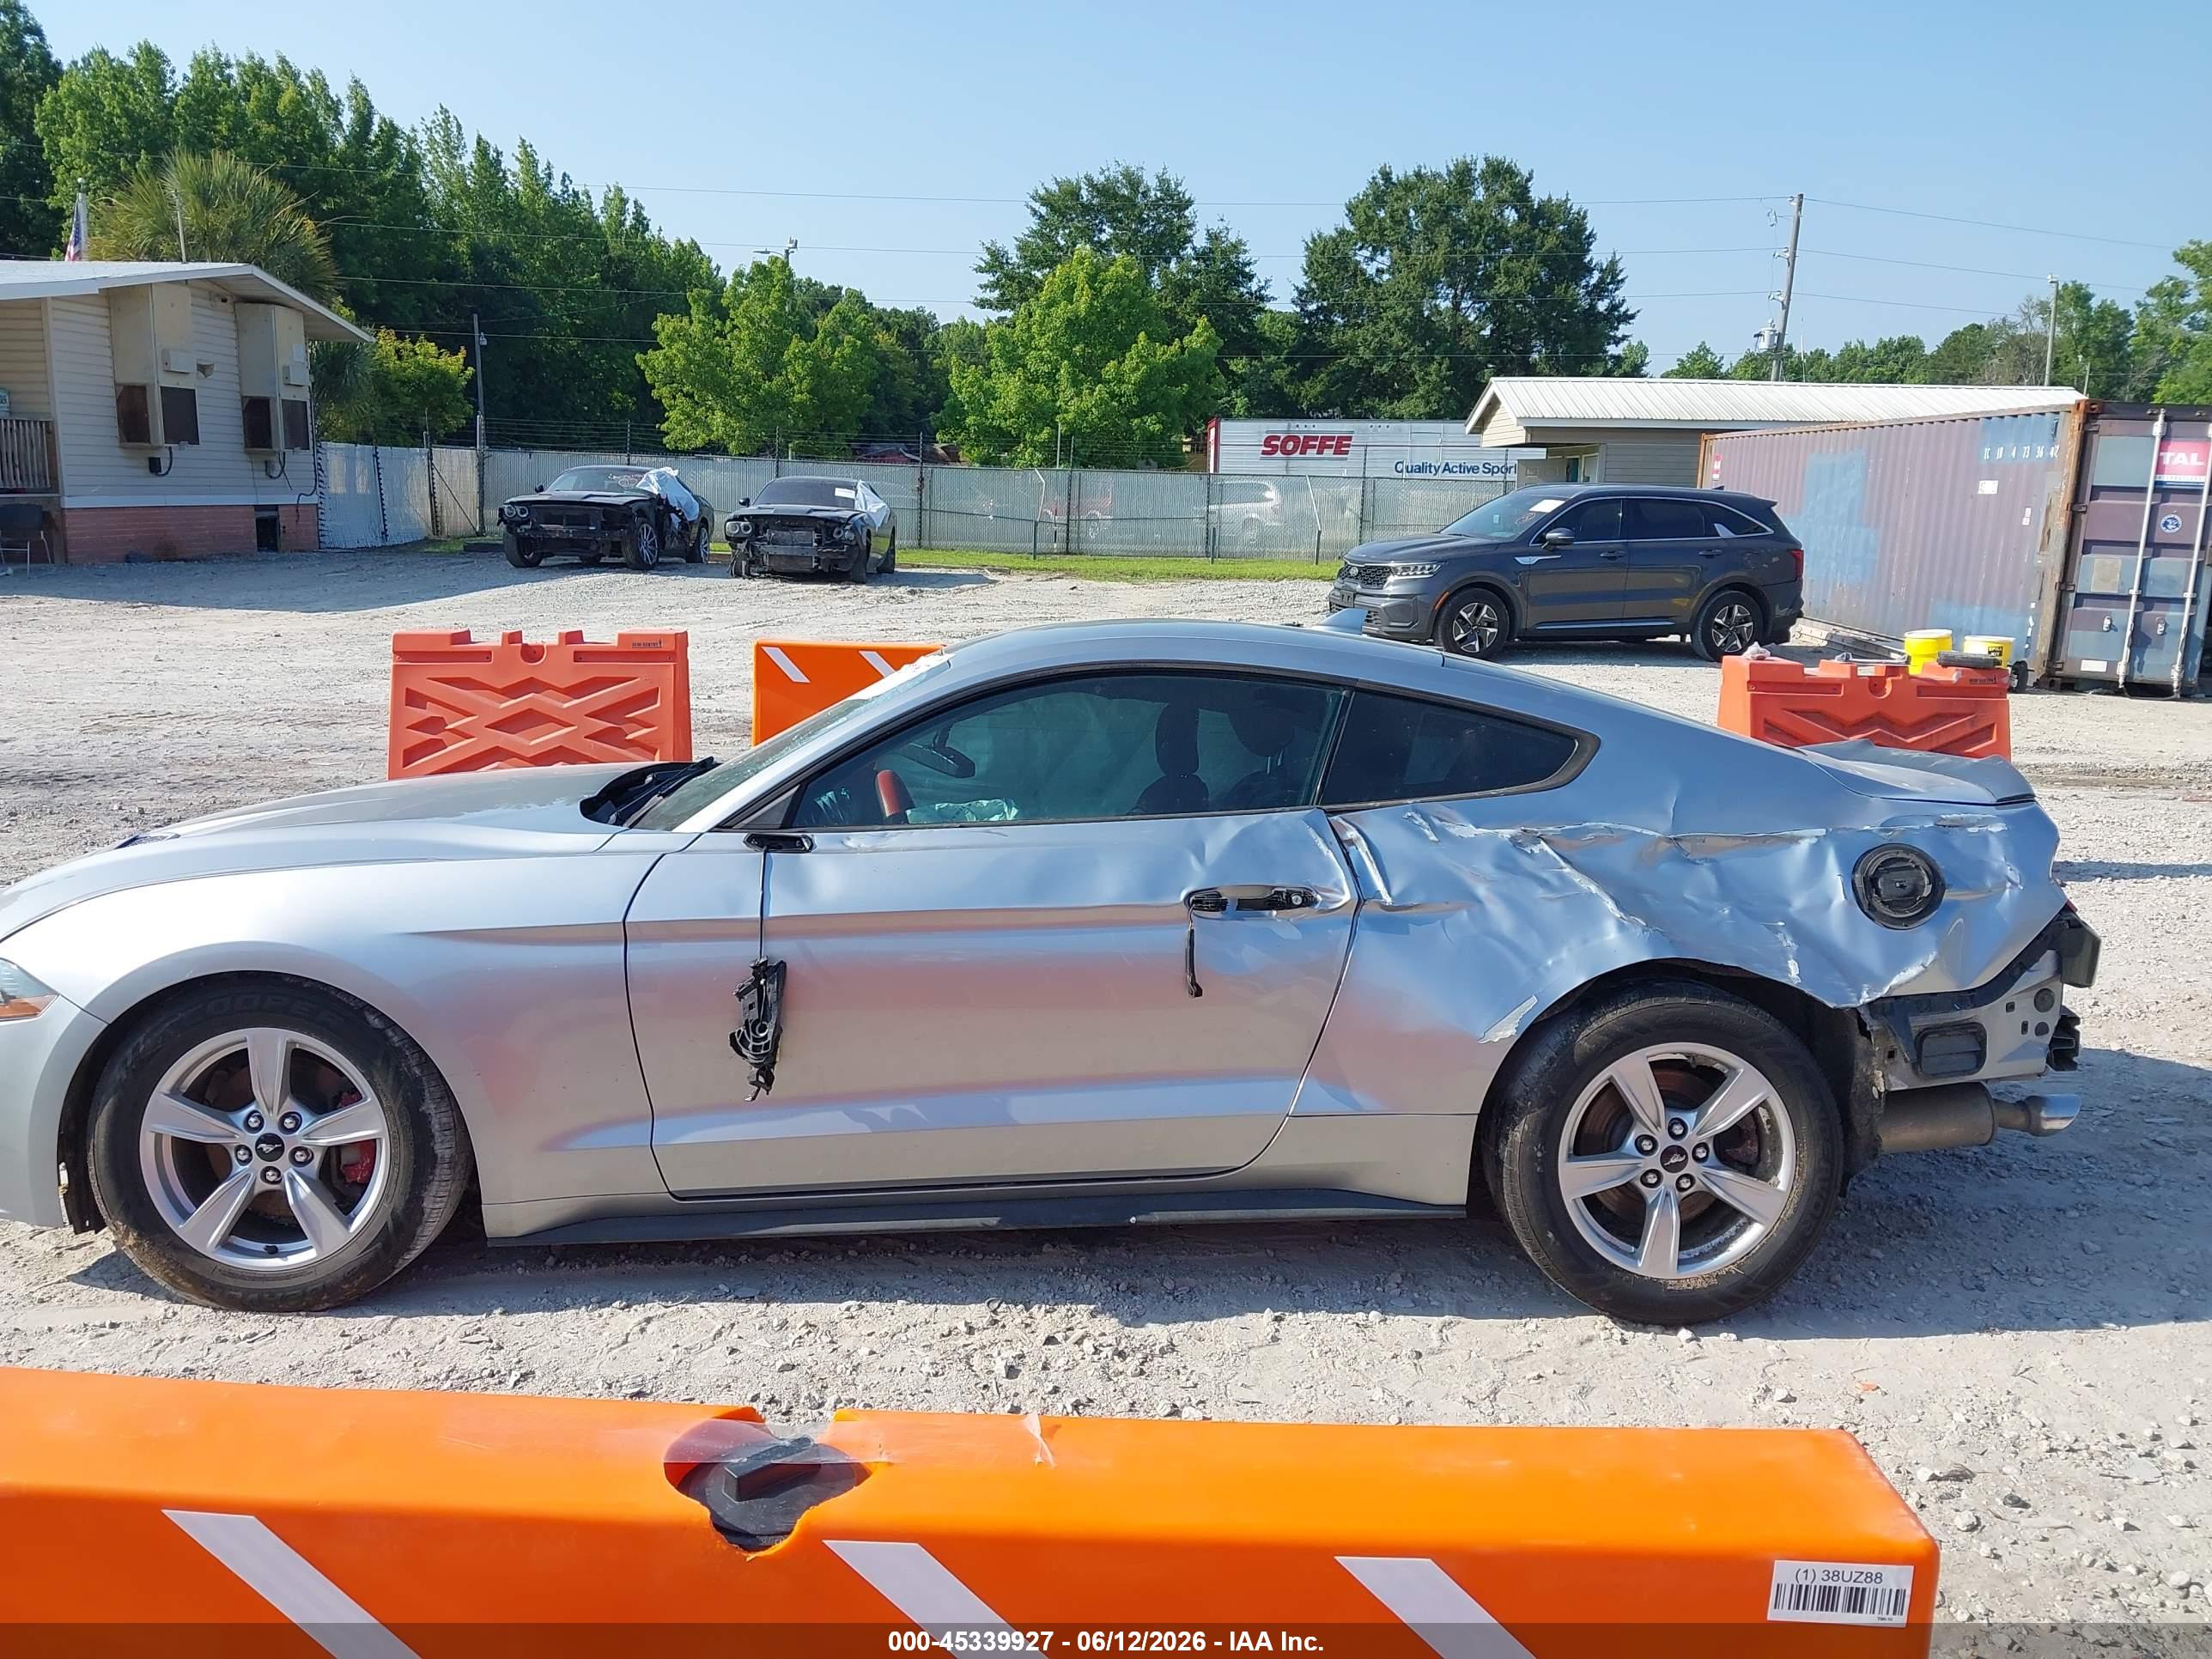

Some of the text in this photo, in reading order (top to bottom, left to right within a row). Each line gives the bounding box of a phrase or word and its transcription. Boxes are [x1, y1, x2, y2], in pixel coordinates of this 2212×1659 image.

[1261, 434, 1352, 456] SOFFE
[2160, 452, 2206, 466] TAL
[1395, 460, 1440, 476] Quality
[1442, 462, 1480, 474] Active
[1795, 1568, 1884, 1584] (1) 38UZ88
